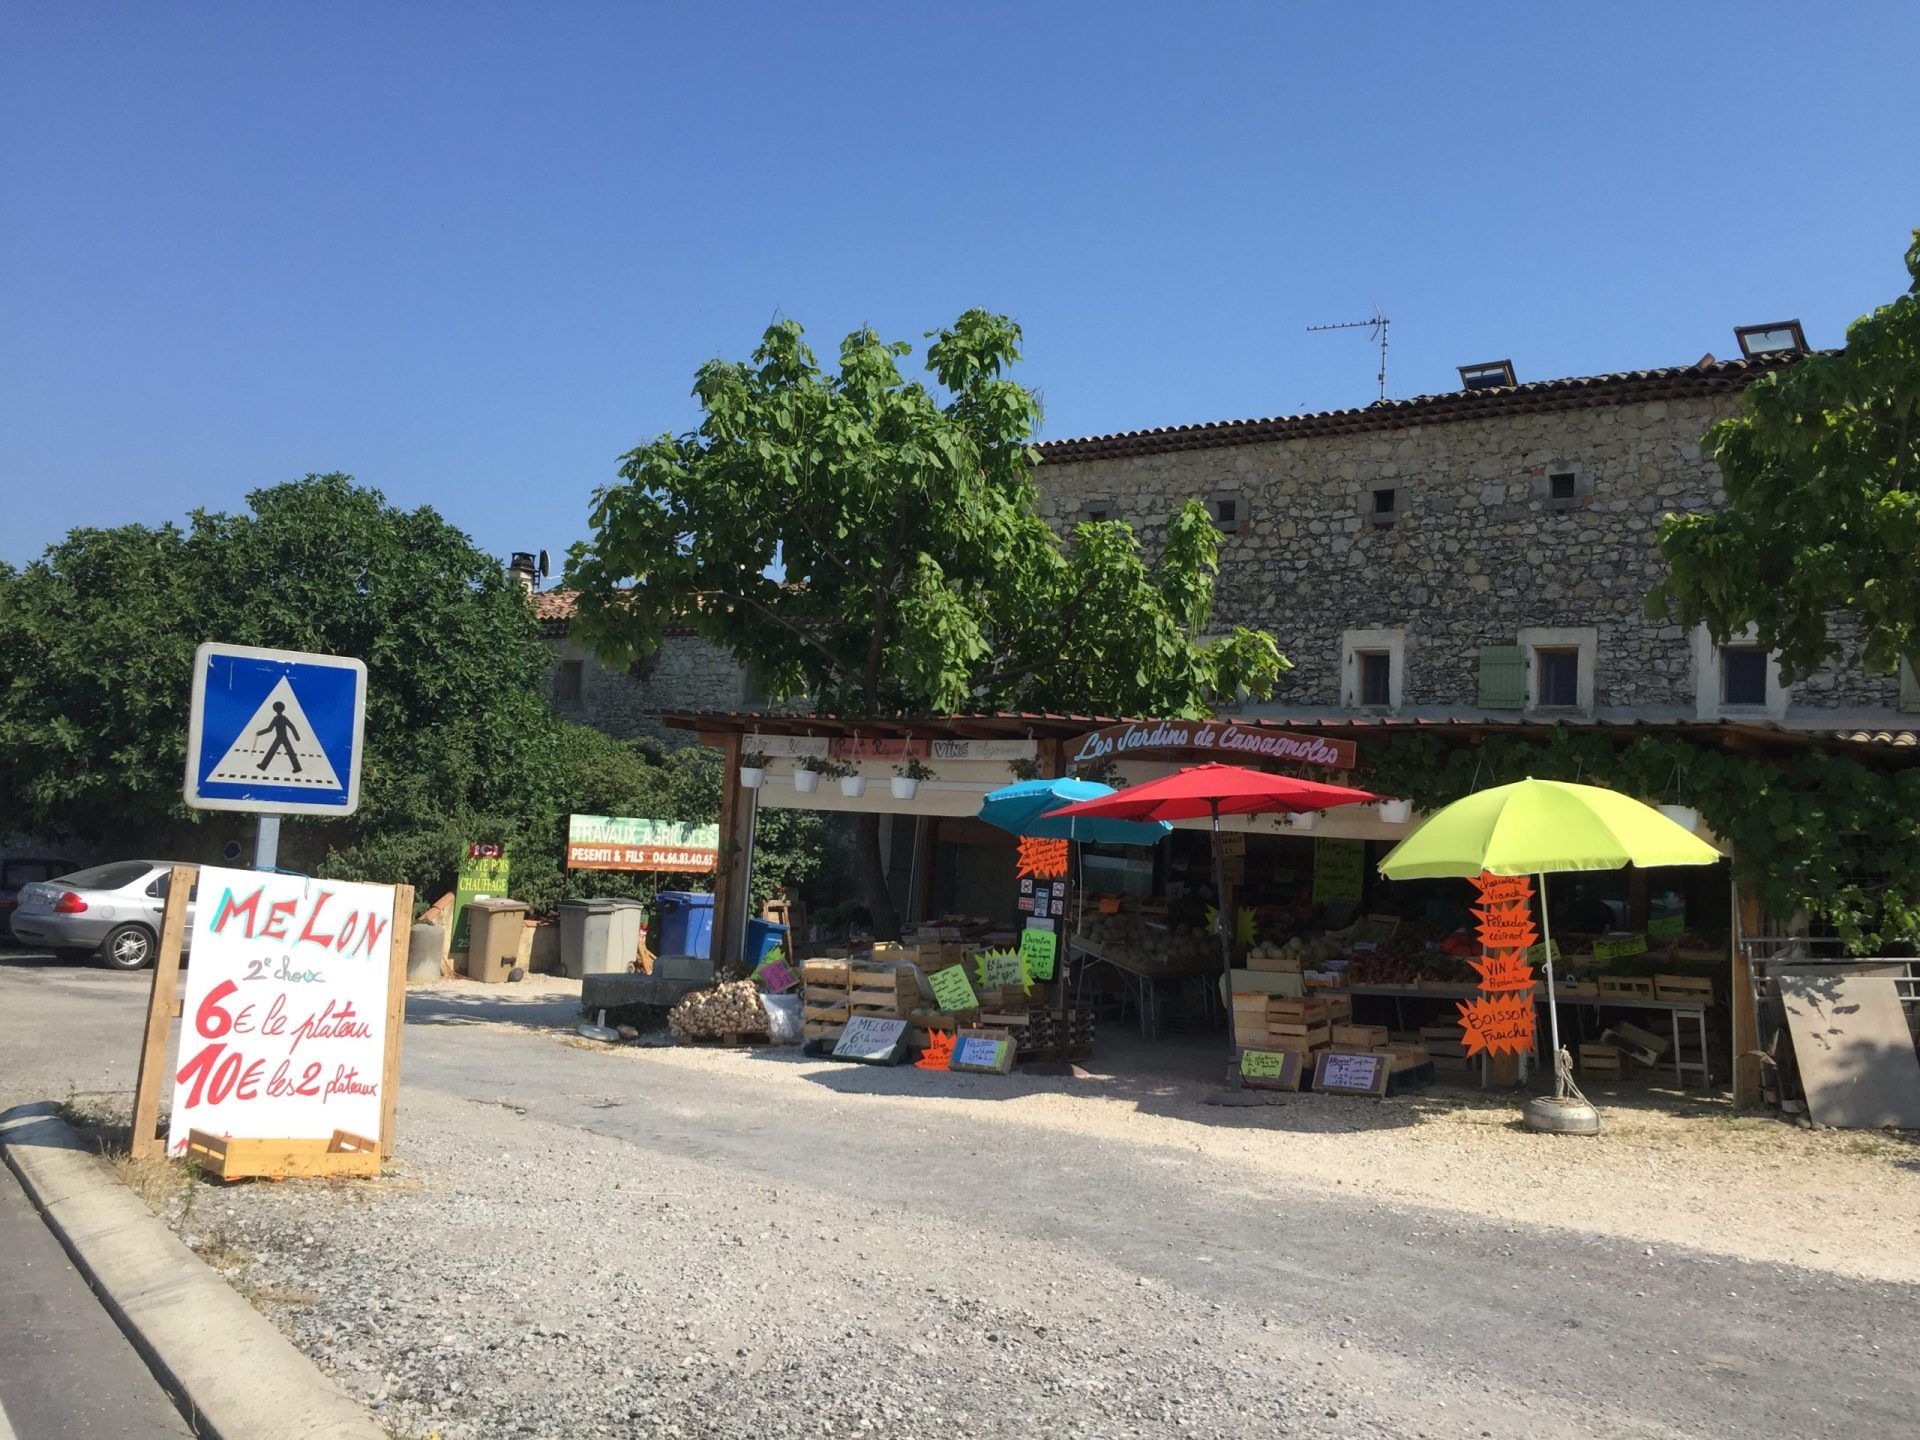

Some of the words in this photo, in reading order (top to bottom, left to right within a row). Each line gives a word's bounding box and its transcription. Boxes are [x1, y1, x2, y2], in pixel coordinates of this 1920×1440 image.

[1074, 733, 1112, 761] Les
[1117, 723, 1188, 752] Jardins
[1194, 724, 1216, 749] de
[1218, 726, 1338, 764] Cassagnoles
[574, 823, 636, 845] TRAVAUX
[571, 847, 611, 862] PESENTI
[614, 850, 621, 863] &
[625, 850, 645, 863] FILS
[460, 877, 508, 892] CHAUFFAGE
[209, 885, 389, 960] MELON
[274, 955, 326, 983] choix
[195, 979, 257, 1039] 6€
[261, 993, 286, 1037] le
[290, 998, 373, 1055] plateau
[857, 1018, 899, 1032] MELON
[1467, 1006, 1529, 1030] Boisson
[176, 1043, 267, 1110] 10€
[266, 1059, 296, 1097] les
[295, 1062, 322, 1097] 2
[323, 1064, 378, 1104] plateaux
